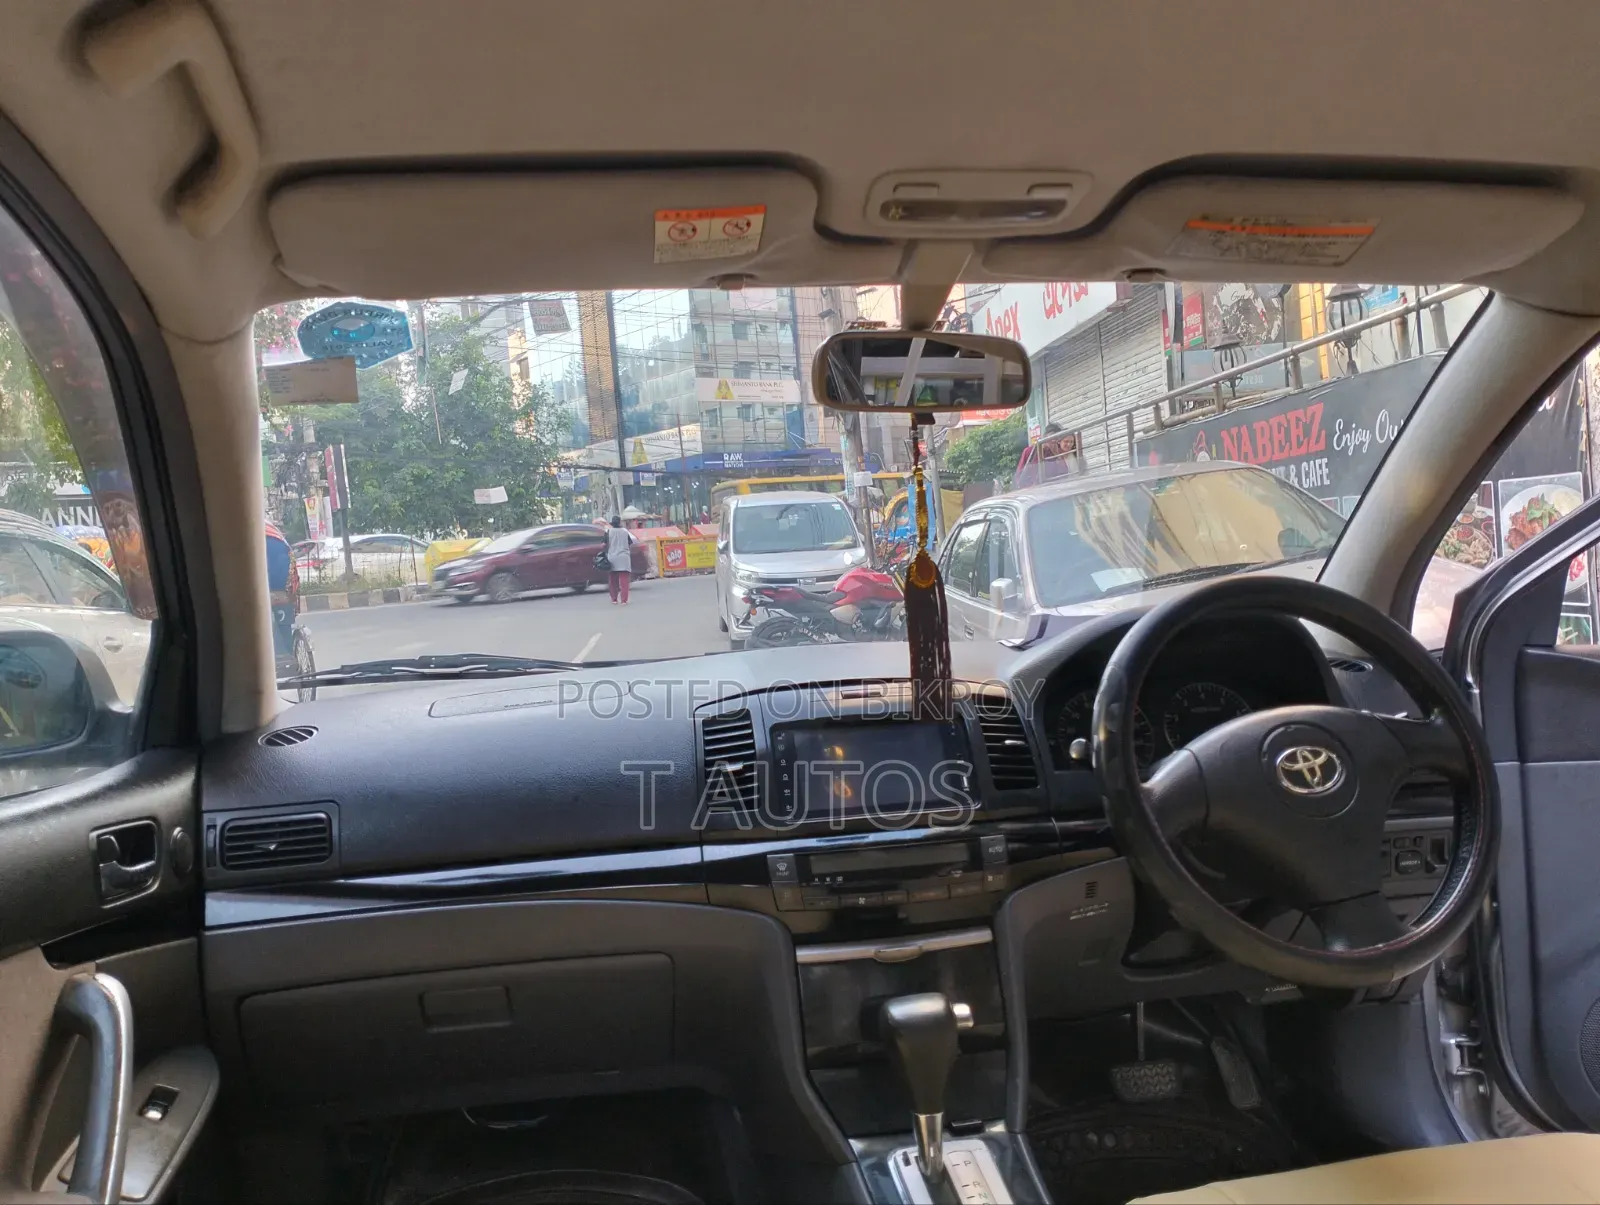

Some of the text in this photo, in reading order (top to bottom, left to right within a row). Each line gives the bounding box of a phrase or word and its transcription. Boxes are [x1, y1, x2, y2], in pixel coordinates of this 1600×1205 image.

[1220, 402, 1326, 465] NABEEZ
[1333, 409, 1404, 455] Enjoy Ou
[1302, 457, 1330, 488] CAFE
